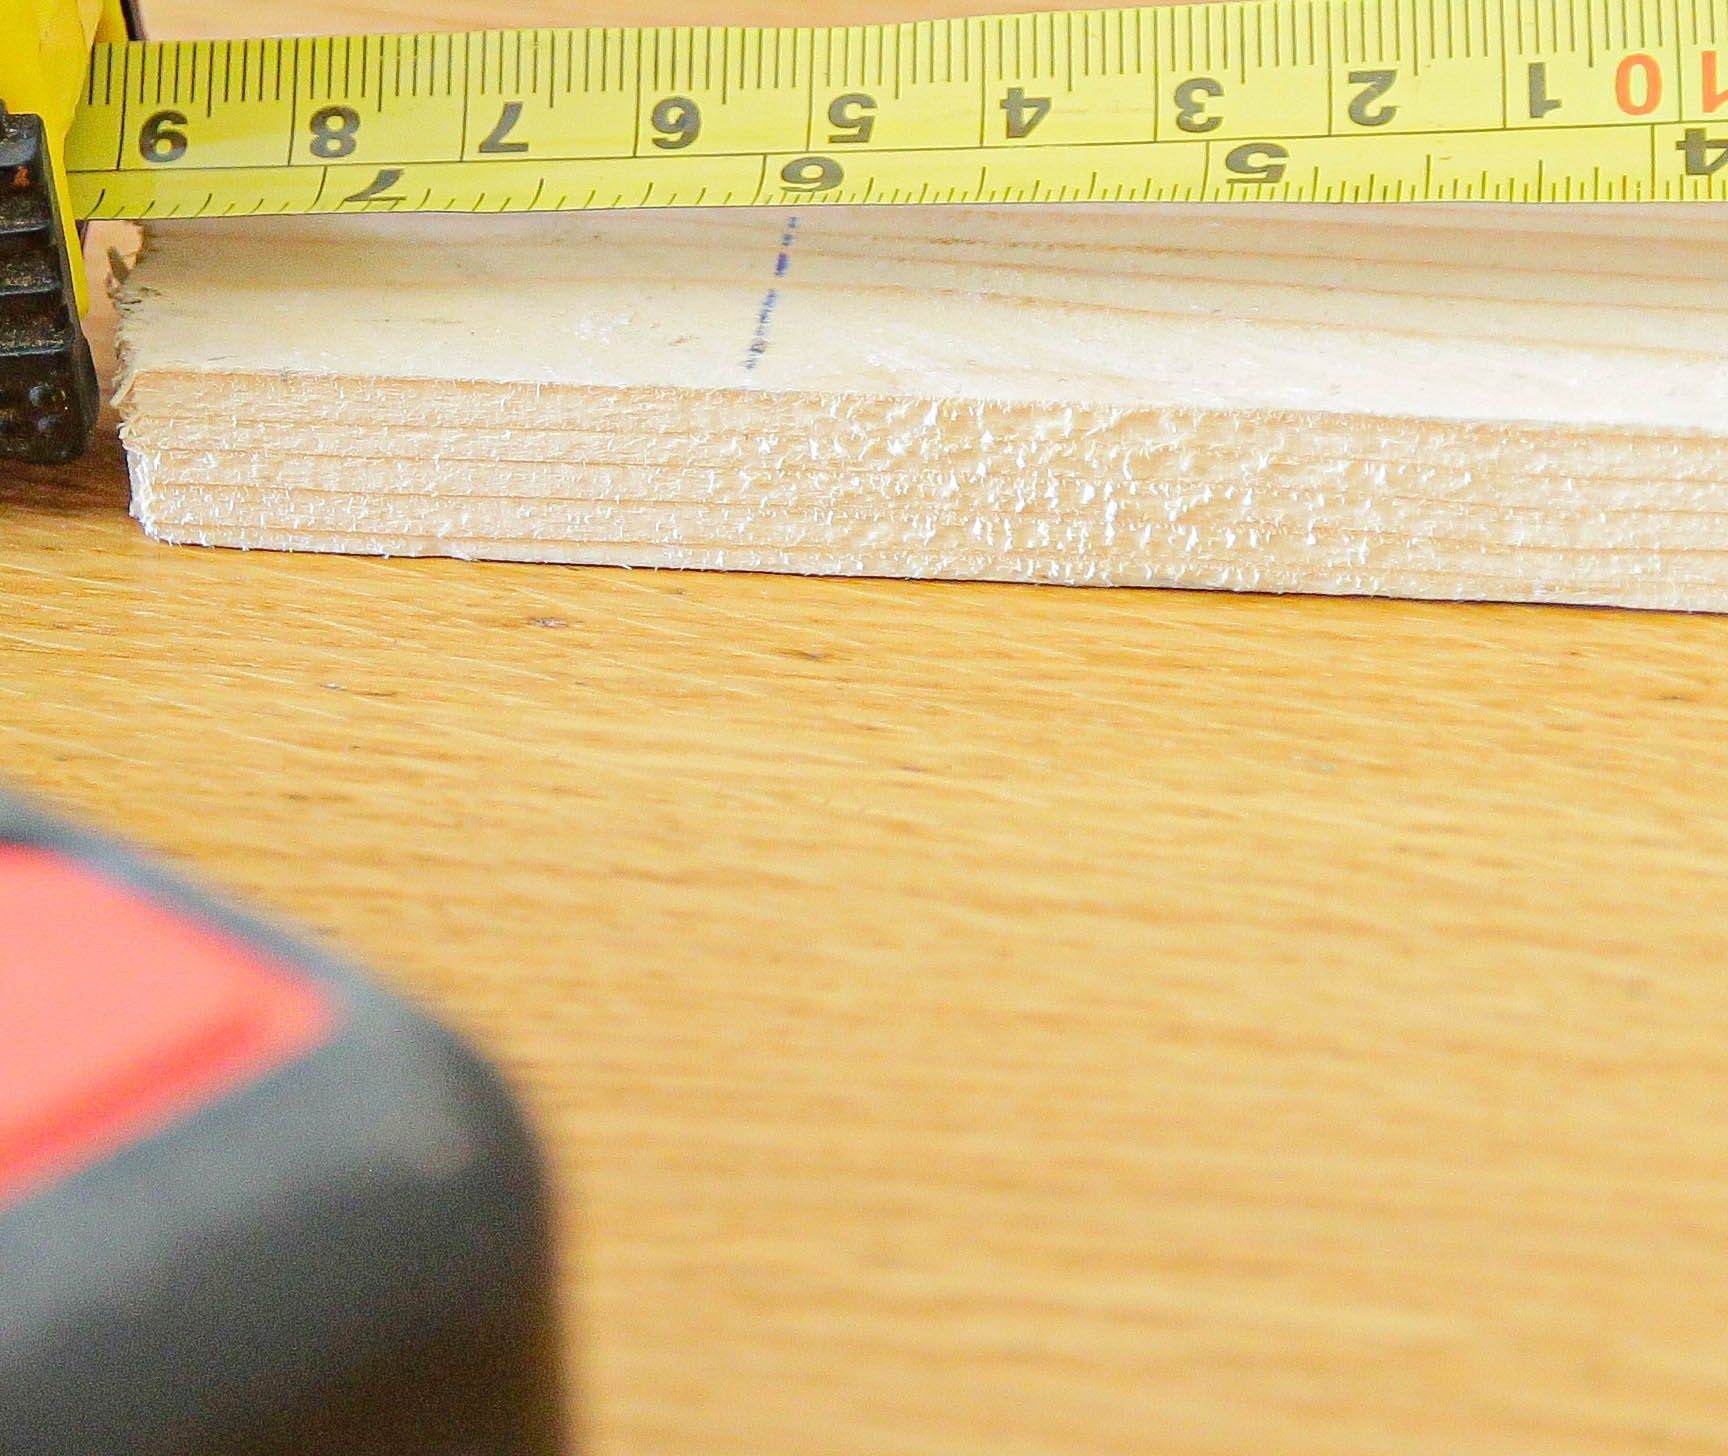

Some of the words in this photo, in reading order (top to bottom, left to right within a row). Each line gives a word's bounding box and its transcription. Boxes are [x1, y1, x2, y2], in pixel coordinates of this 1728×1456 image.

[999, 87, 1052, 140] 4
[1173, 78, 1225, 134] 3
[1347, 69, 1399, 127] 2
[1528, 61, 1562, 119] 1
[139, 110, 189, 164] 9
[309, 105, 361, 159] 8
[478, 102, 530, 154] 7
[651, 97, 702, 150] 6
[828, 93, 878, 144] 5
[344, 169, 407, 205] 7
[780, 156, 845, 193] 6
[1224, 143, 1290, 185] 5
